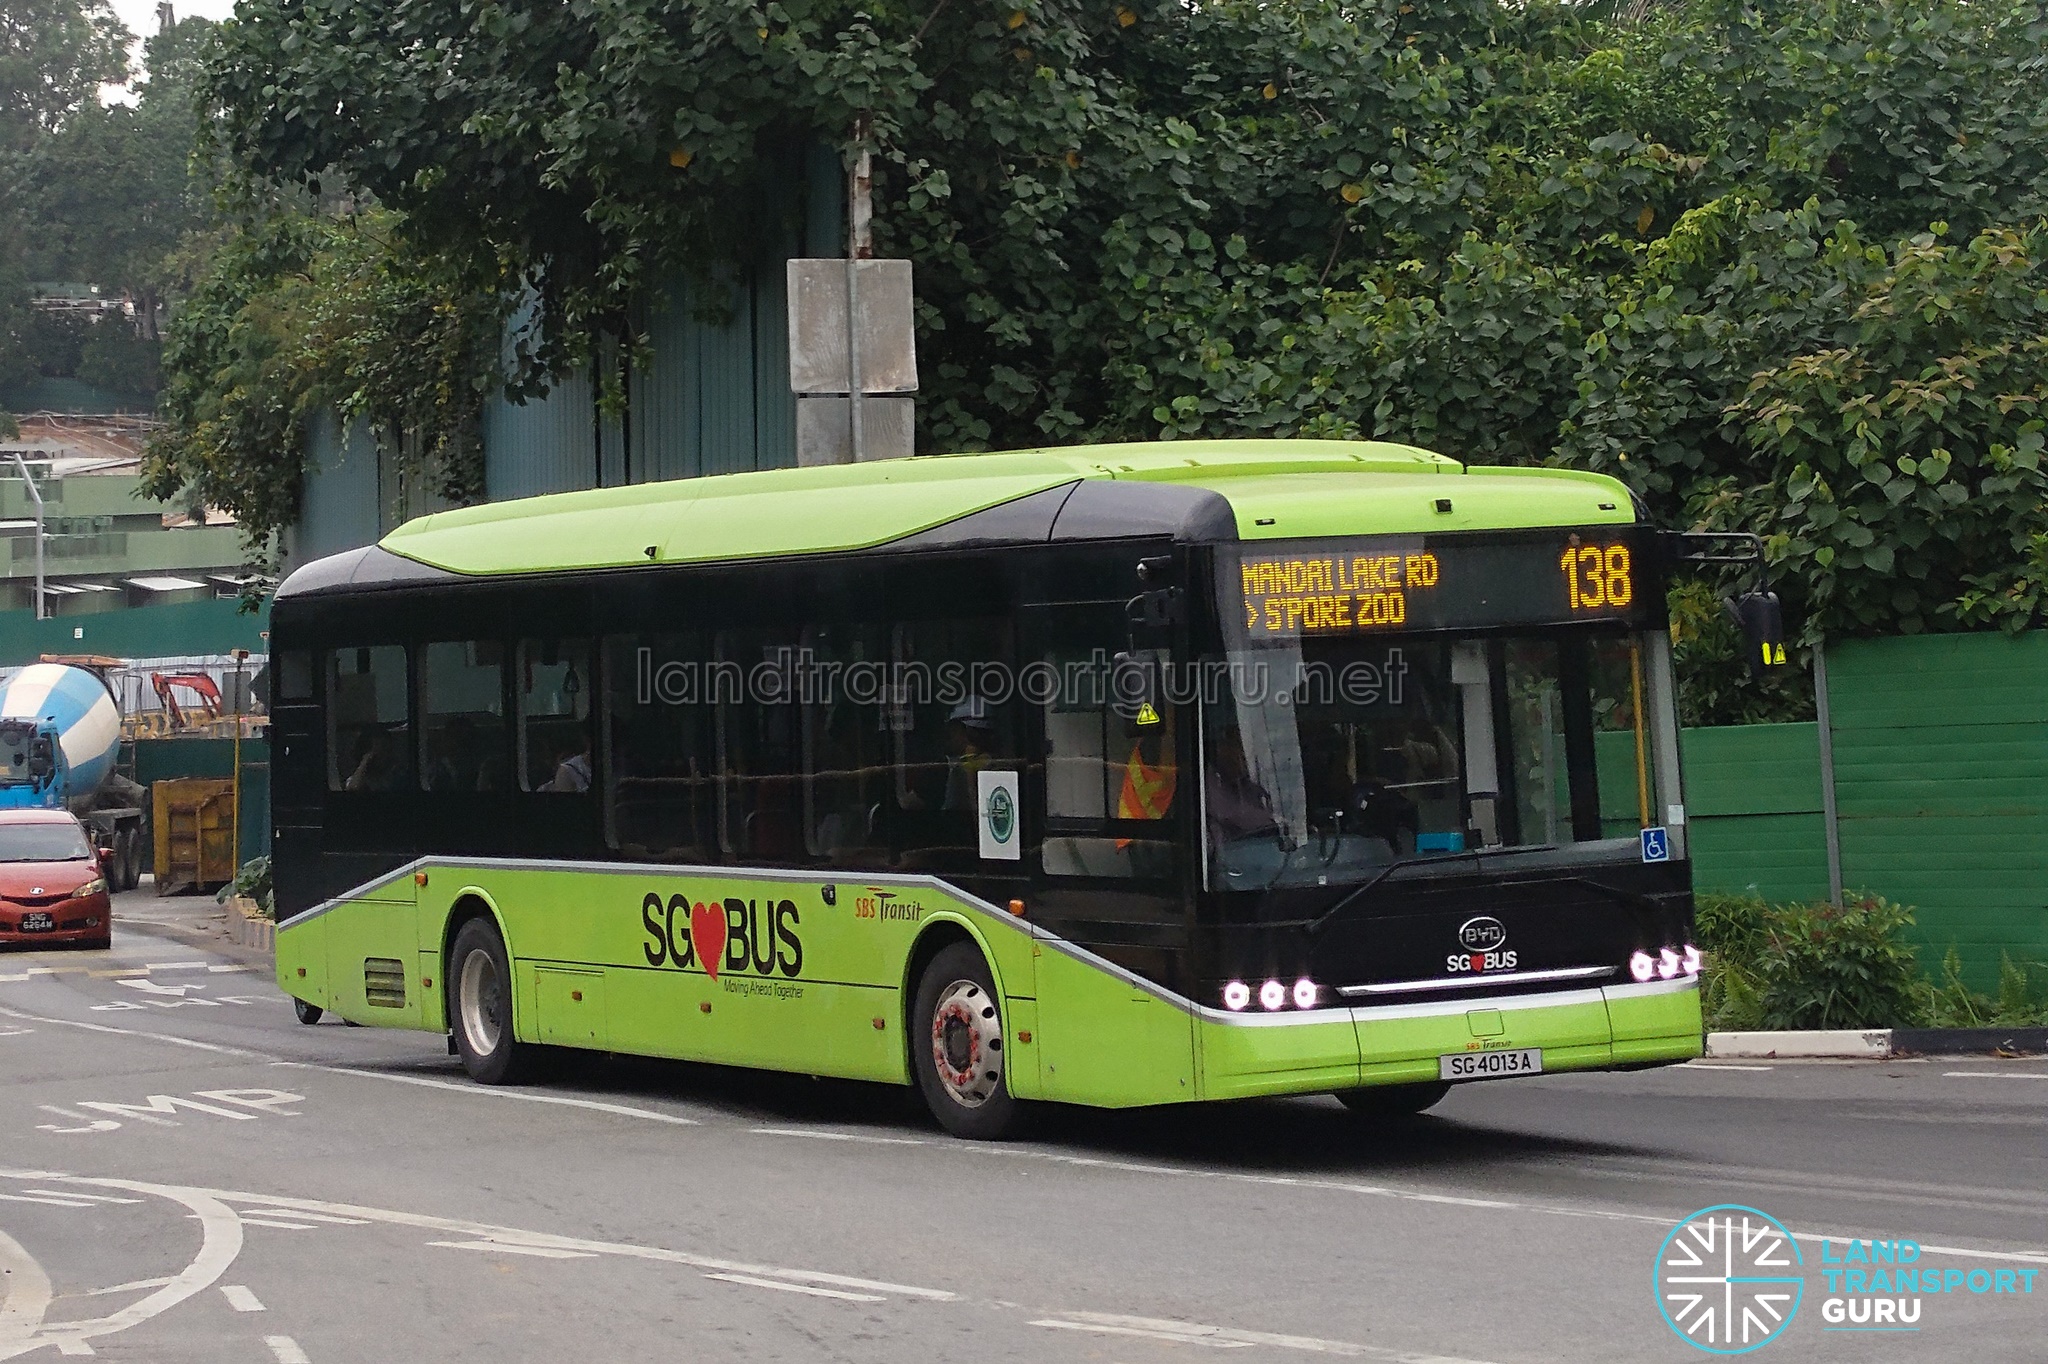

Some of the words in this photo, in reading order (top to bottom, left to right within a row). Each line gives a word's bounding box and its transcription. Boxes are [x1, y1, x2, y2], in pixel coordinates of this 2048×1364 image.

[1241, 558, 1335, 595] MANDAI
[1338, 555, 1402, 591] LAKE
[1406, 553, 1440, 588] RD
[1560, 545, 1631, 609] 138
[1264, 594, 1353, 631] S'PORE
[1356, 591, 1407, 626] ZOO
[854, 897, 876, 918] SBS
[874, 892, 925, 923] Transit
[1465, 926, 1500, 943] BYD
[724, 978, 749, 998] Moving
[749, 981, 772, 997] Ahead
[773, 982, 804, 1001] Together
[1451, 1052, 1532, 1075] SG4013A
